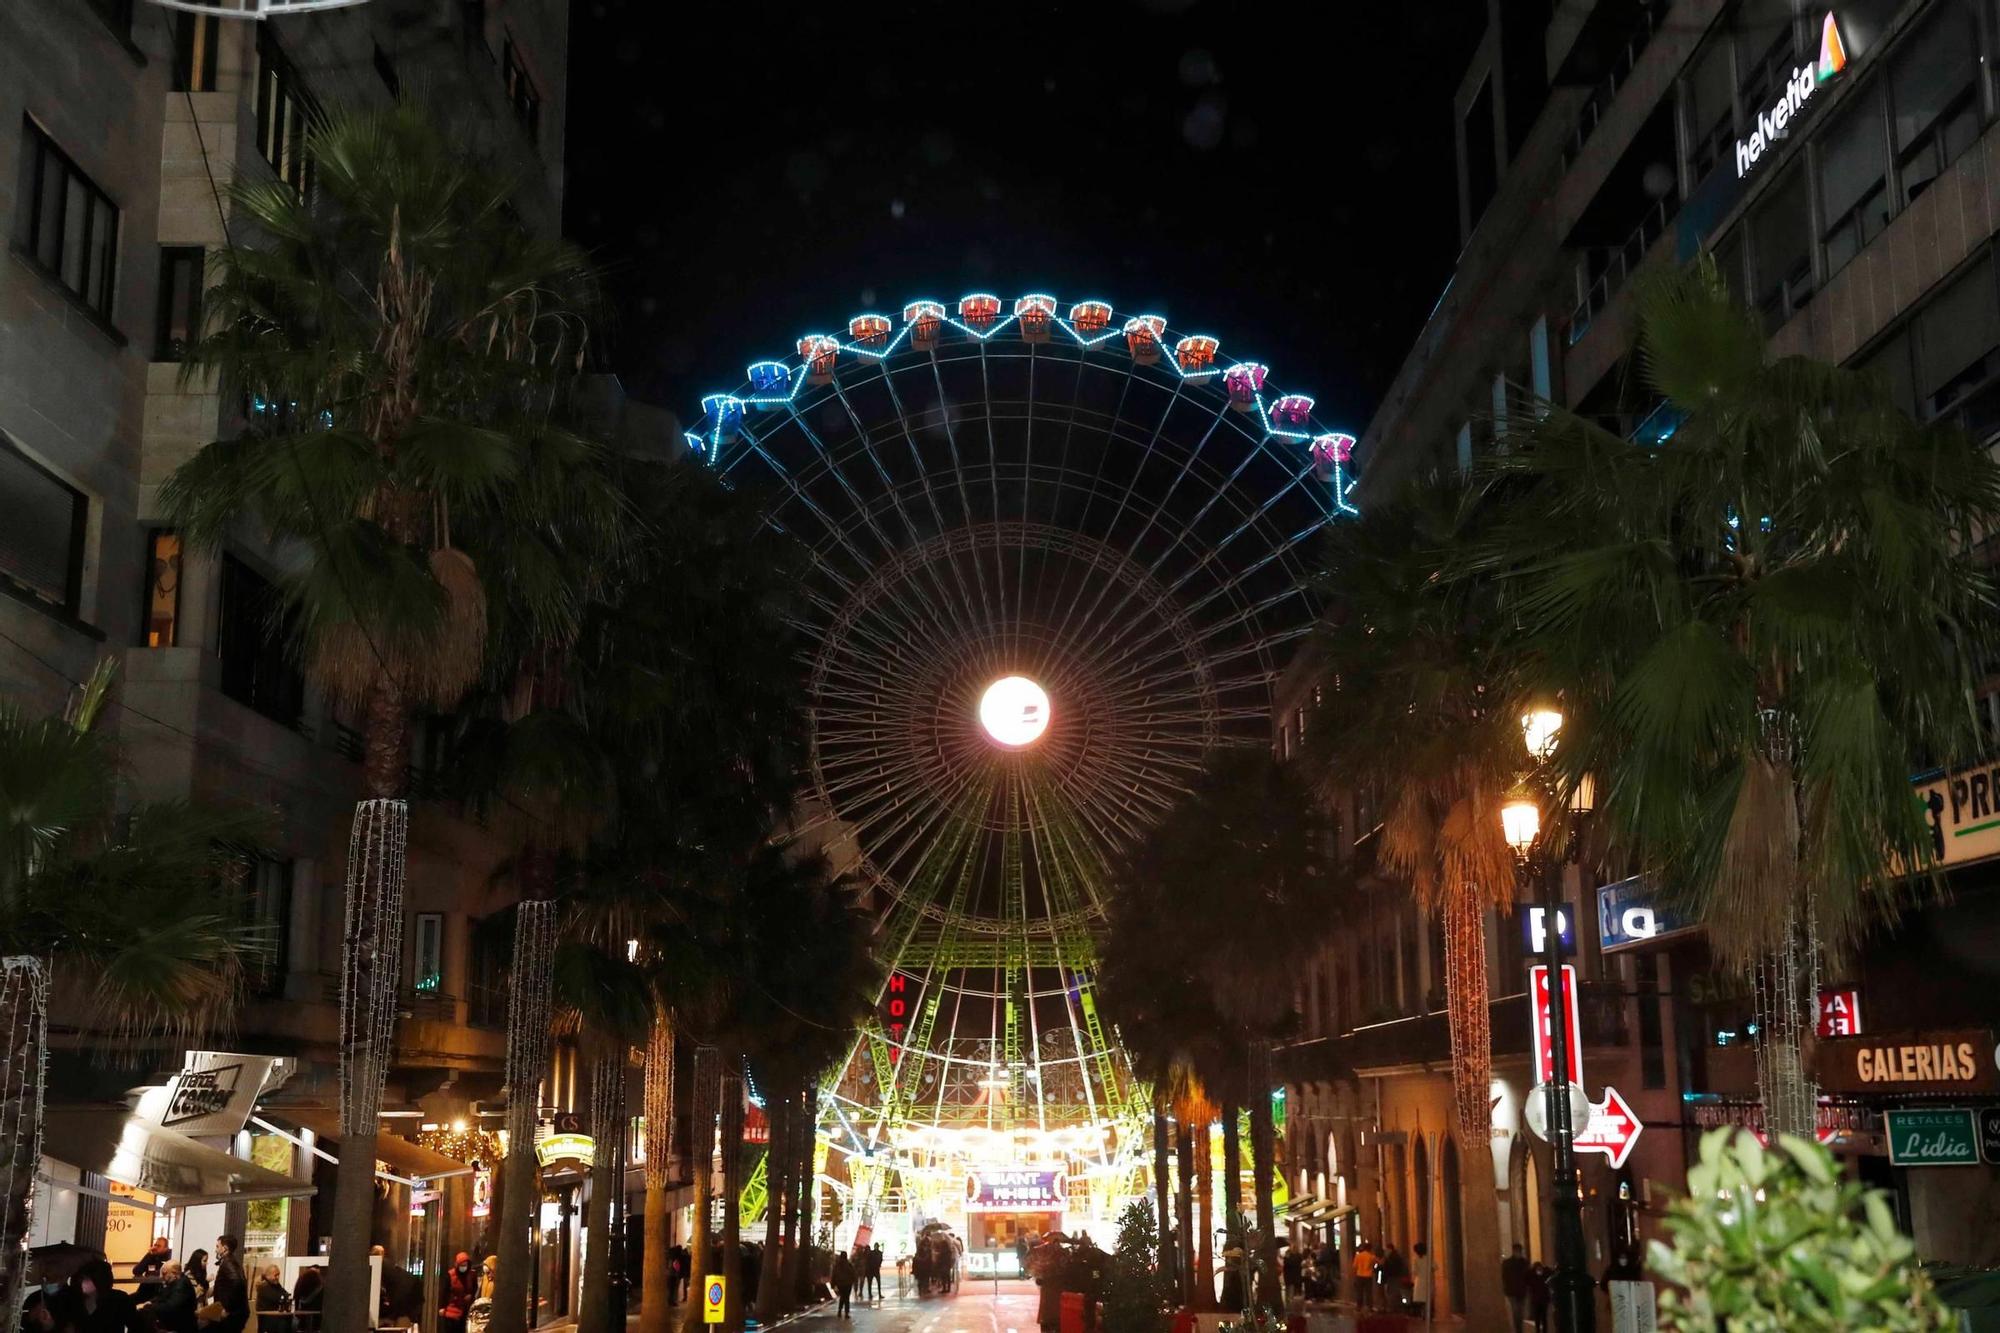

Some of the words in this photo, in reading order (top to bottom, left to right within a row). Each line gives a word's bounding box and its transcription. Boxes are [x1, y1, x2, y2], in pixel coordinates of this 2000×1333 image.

[1736, 61, 1815, 178] helvetia
[1857, 1043, 1976, 1082] GALERIAS
[1897, 1115, 1964, 1125] RETALES
[1898, 1131, 1970, 1158] Lidia
